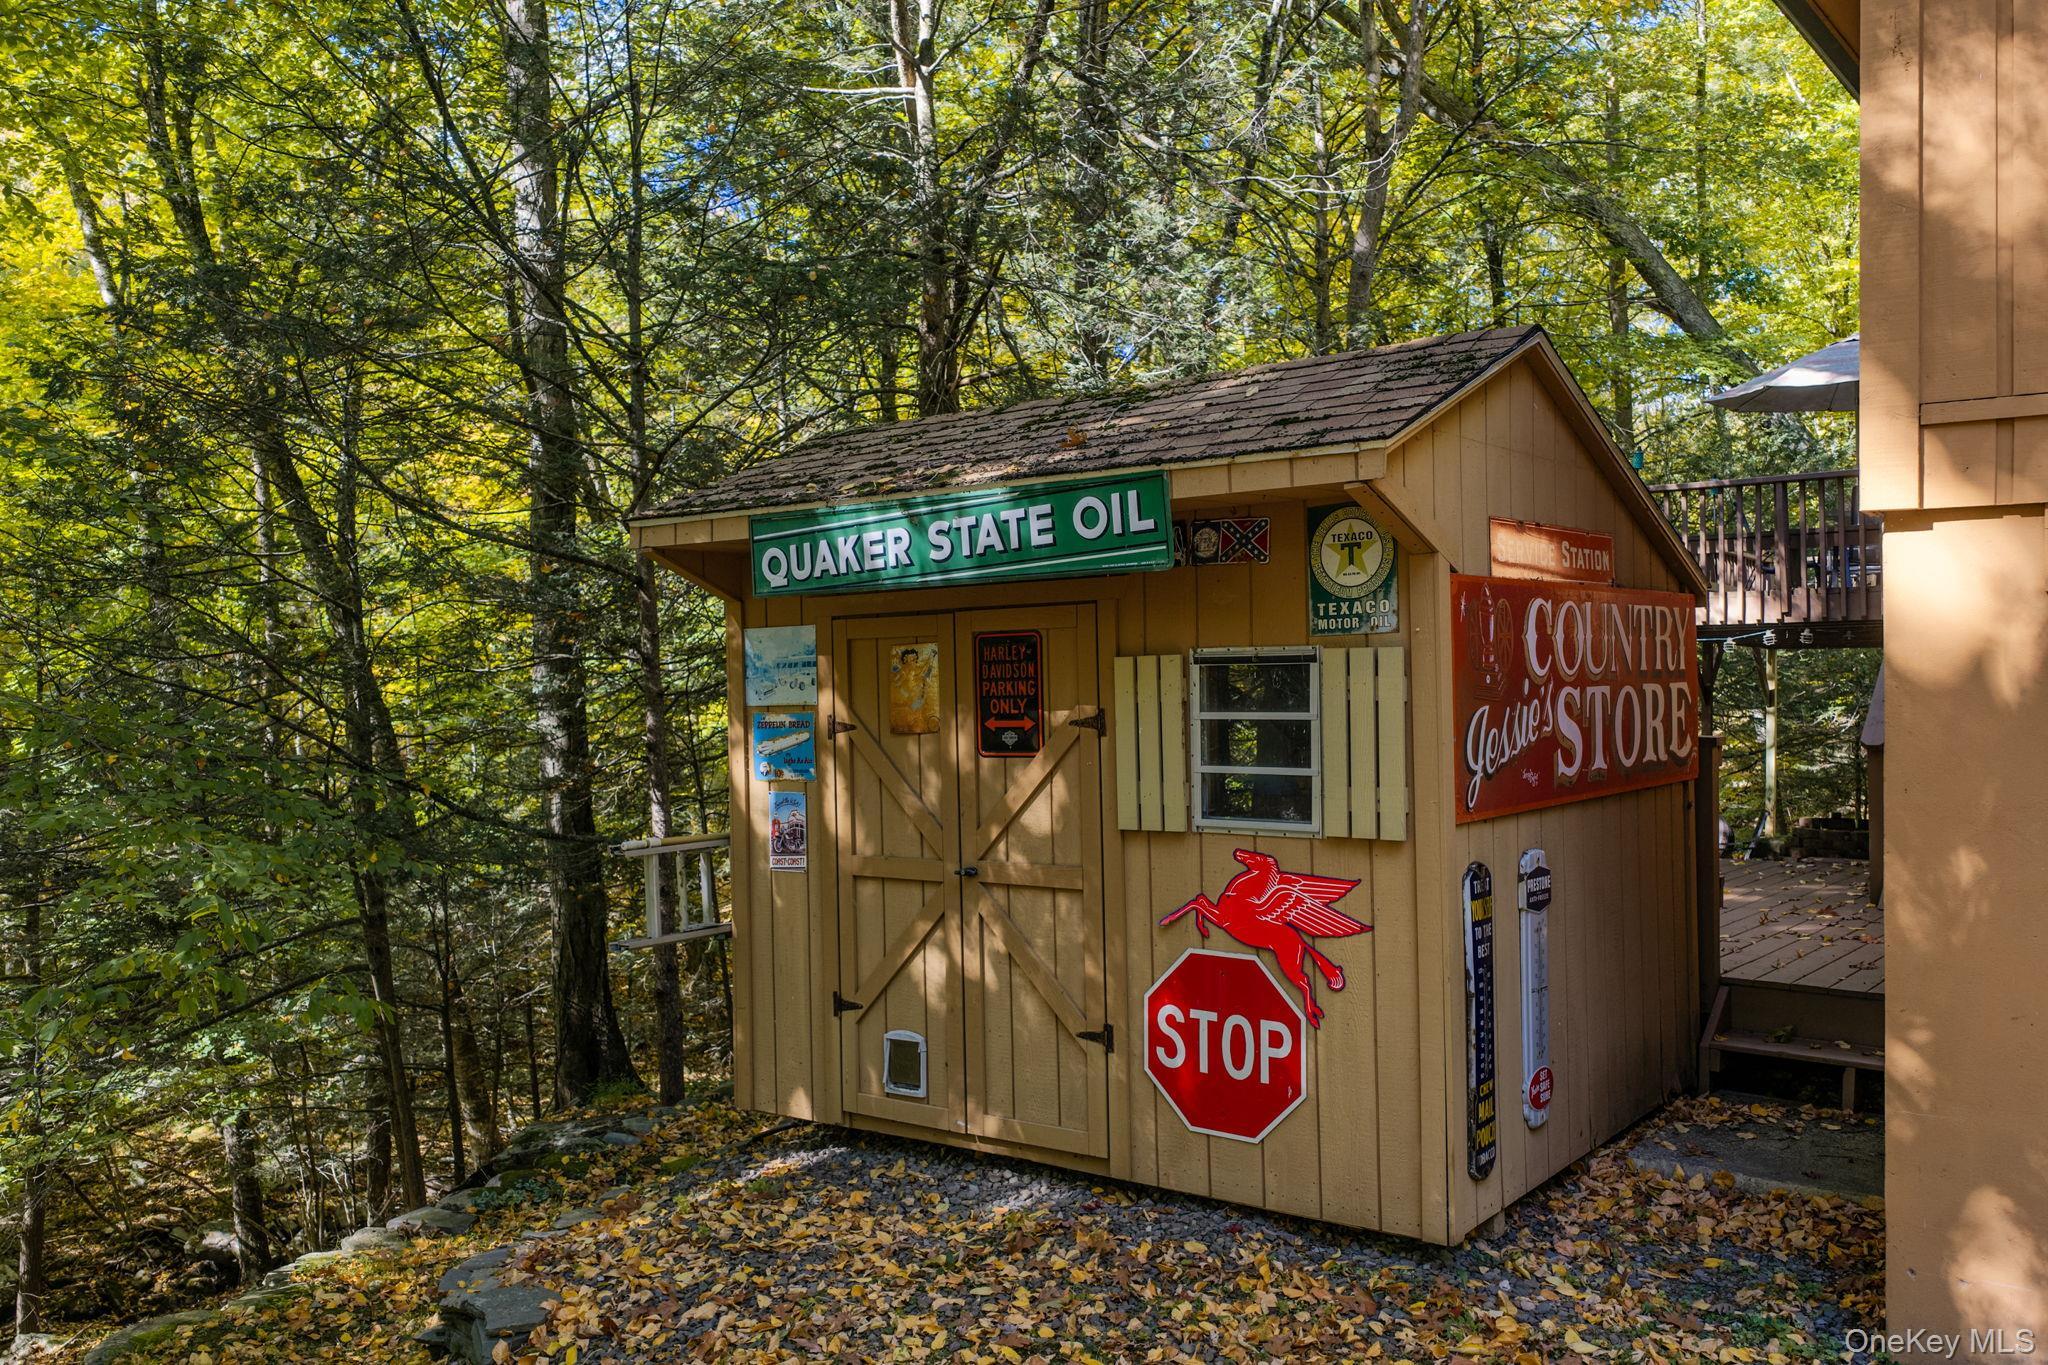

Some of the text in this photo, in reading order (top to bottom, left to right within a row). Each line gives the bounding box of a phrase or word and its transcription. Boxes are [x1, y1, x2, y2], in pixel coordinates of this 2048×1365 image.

[761, 489, 1156, 588] QUAKER STATE OIL
[1331, 531, 1373, 543] TEXACO
[1340, 542, 1361, 566] T
[1496, 532, 1610, 571] SERVICE STATION
[1317, 600, 1390, 616] TEXACO
[1318, 616, 1391, 630] MOTOR OIL
[1524, 598, 1690, 678] COUNTRY
[982, 663, 1035, 679] DAVIDSON
[983, 681, 1036, 696] PARKING
[990, 698, 1027, 714] ONLY
[757, 720, 811, 729] ZEPPELIN BREAD
[1556, 682, 1692, 778] STORE
[1467, 677, 1553, 812] Jessie's
[1473, 877, 1490, 895] TRET
[1527, 875, 1551, 893] PRESTONE
[1474, 922, 1492, 940] TO THE
[1477, 943, 1490, 959] BEST
[1156, 1004, 1293, 1085] STOP
[1540, 1069, 1548, 1081] SET
[1540, 1079, 1550, 1092] SAFE
[1478, 1096, 1494, 1122] MAIL
